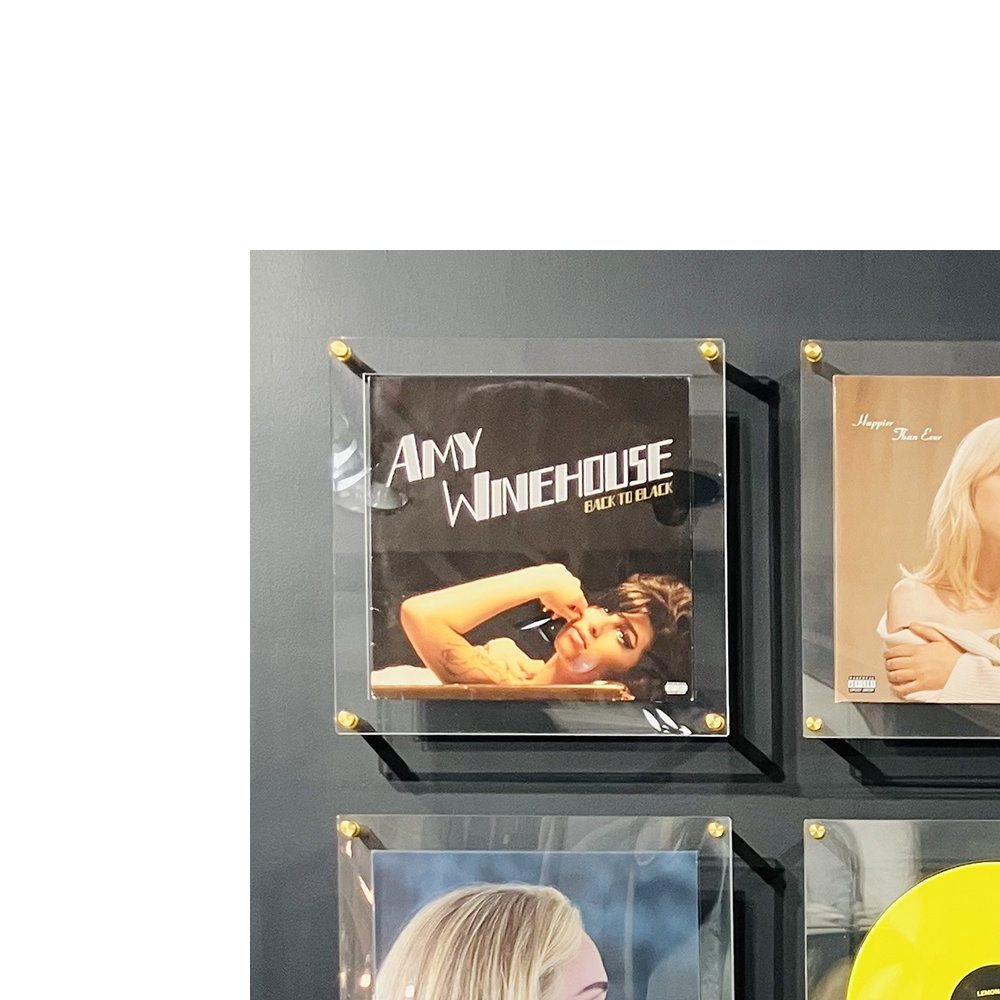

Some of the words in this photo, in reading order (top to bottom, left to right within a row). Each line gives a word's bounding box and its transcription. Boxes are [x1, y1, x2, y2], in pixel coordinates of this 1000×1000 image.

[851, 413, 894, 430] Happier
[892, 427, 919, 441] Than
[920, 427, 943, 441] Ever
[386, 427, 483, 483] AMY
[442, 438, 674, 527] WINEHOUSE
[584, 494, 616, 514] BACK
[618, 490, 633, 506] TO
[635, 481, 674, 502] BLACK
